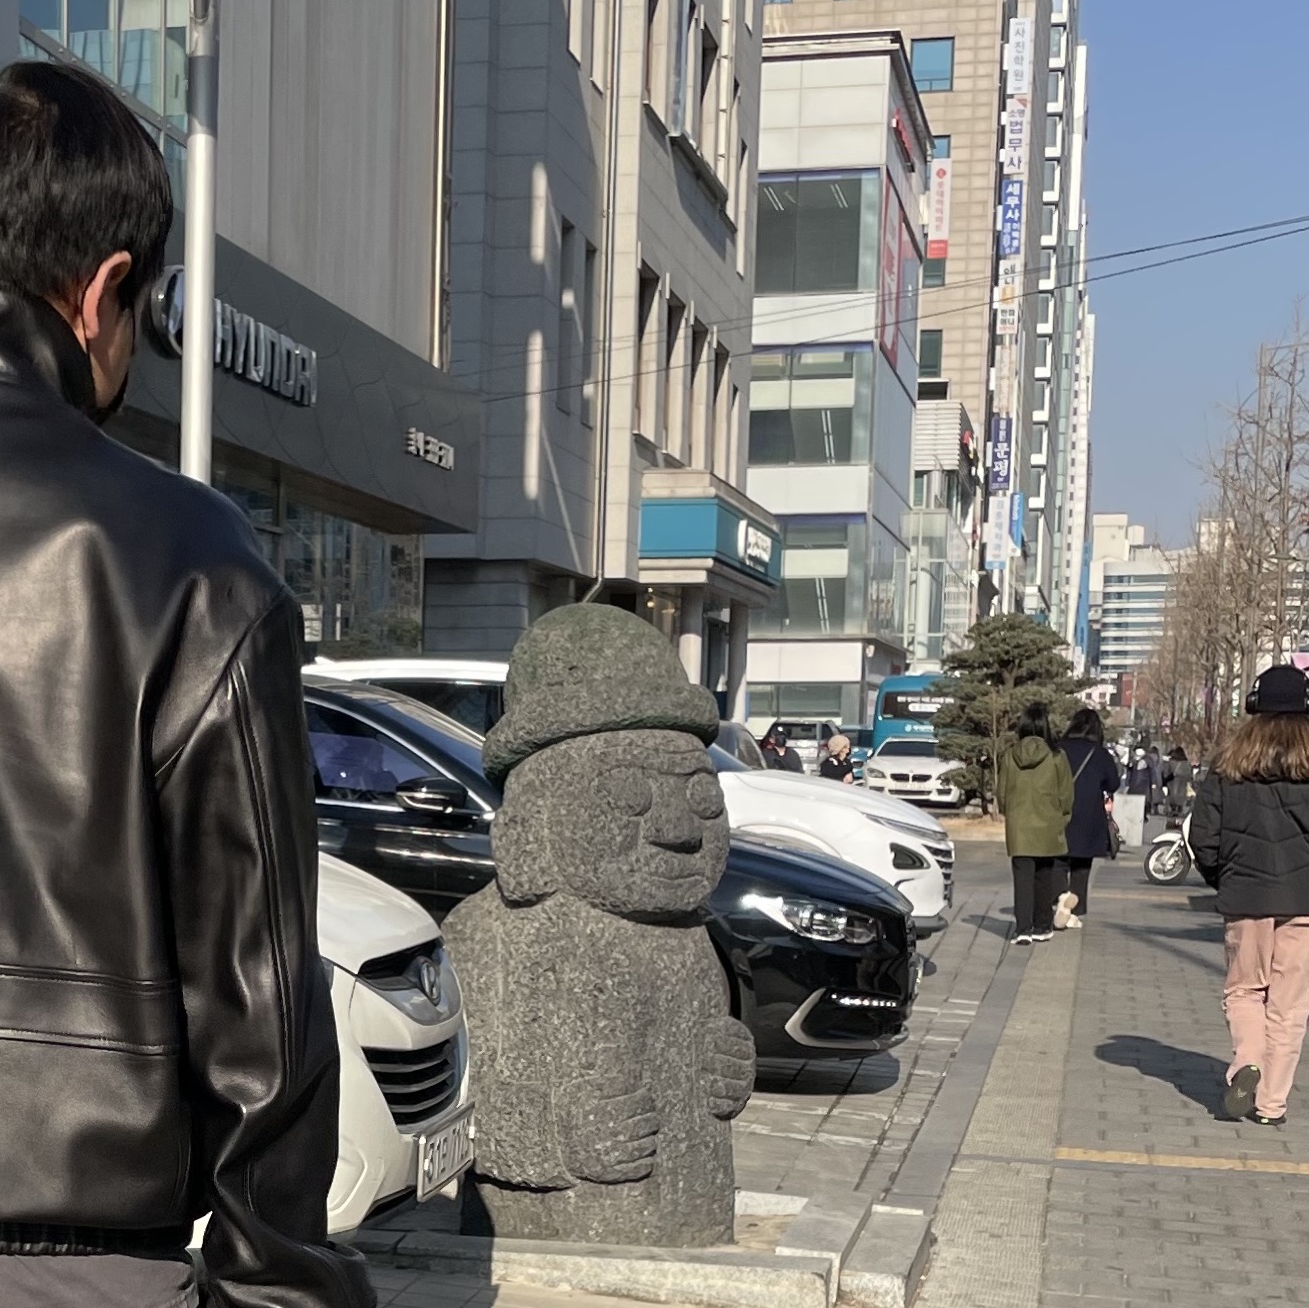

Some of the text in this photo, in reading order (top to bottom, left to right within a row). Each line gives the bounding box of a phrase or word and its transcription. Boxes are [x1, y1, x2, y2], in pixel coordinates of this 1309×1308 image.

[1007, 120, 1023, 170] 법무사
[1005, 182, 1021, 221] 세무사
[213, 298, 317, 408] HYUNDAI
